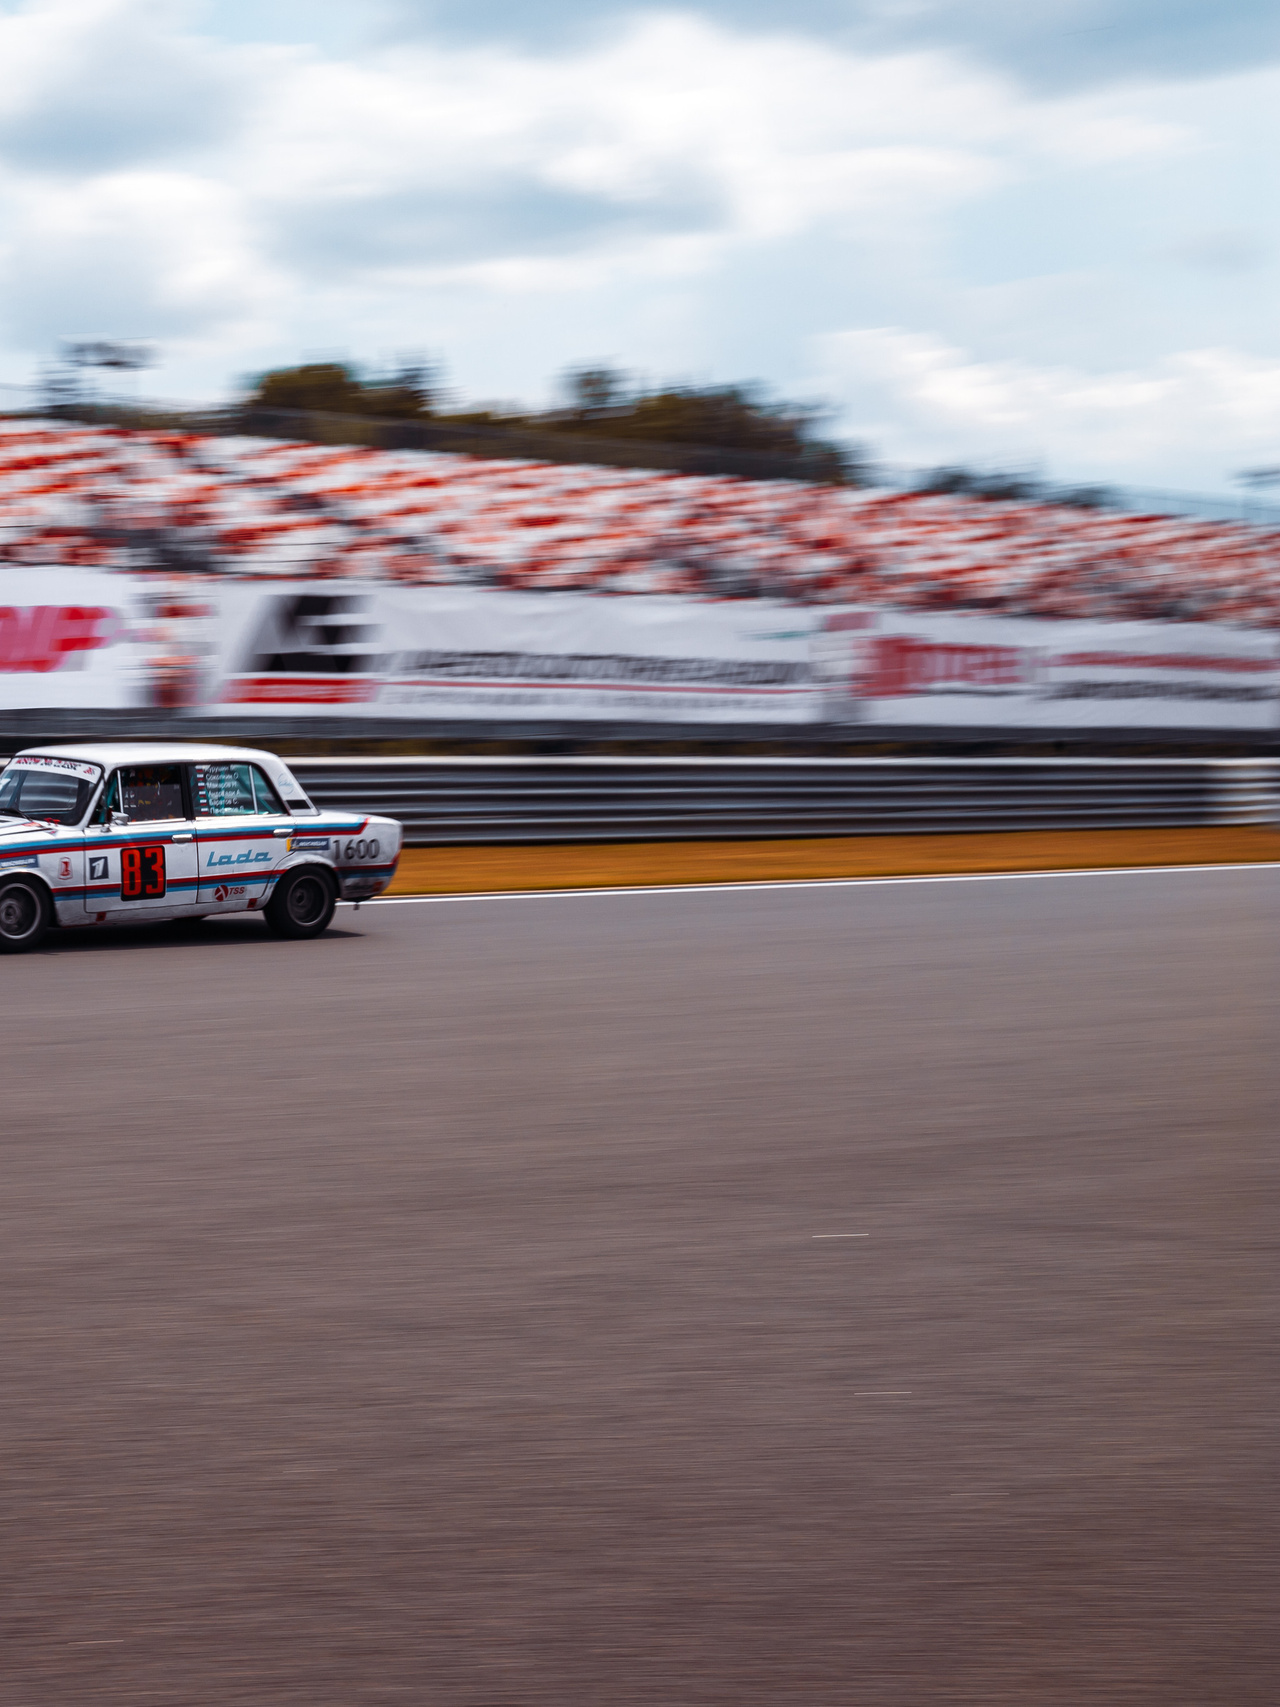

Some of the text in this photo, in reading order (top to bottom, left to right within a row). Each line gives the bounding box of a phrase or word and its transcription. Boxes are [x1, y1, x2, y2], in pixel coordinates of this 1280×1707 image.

[206, 849, 273, 867] Lada
[332, 838, 380, 860] 1600
[122, 847, 164, 896] 83
[229, 886, 245, 895] TSS
